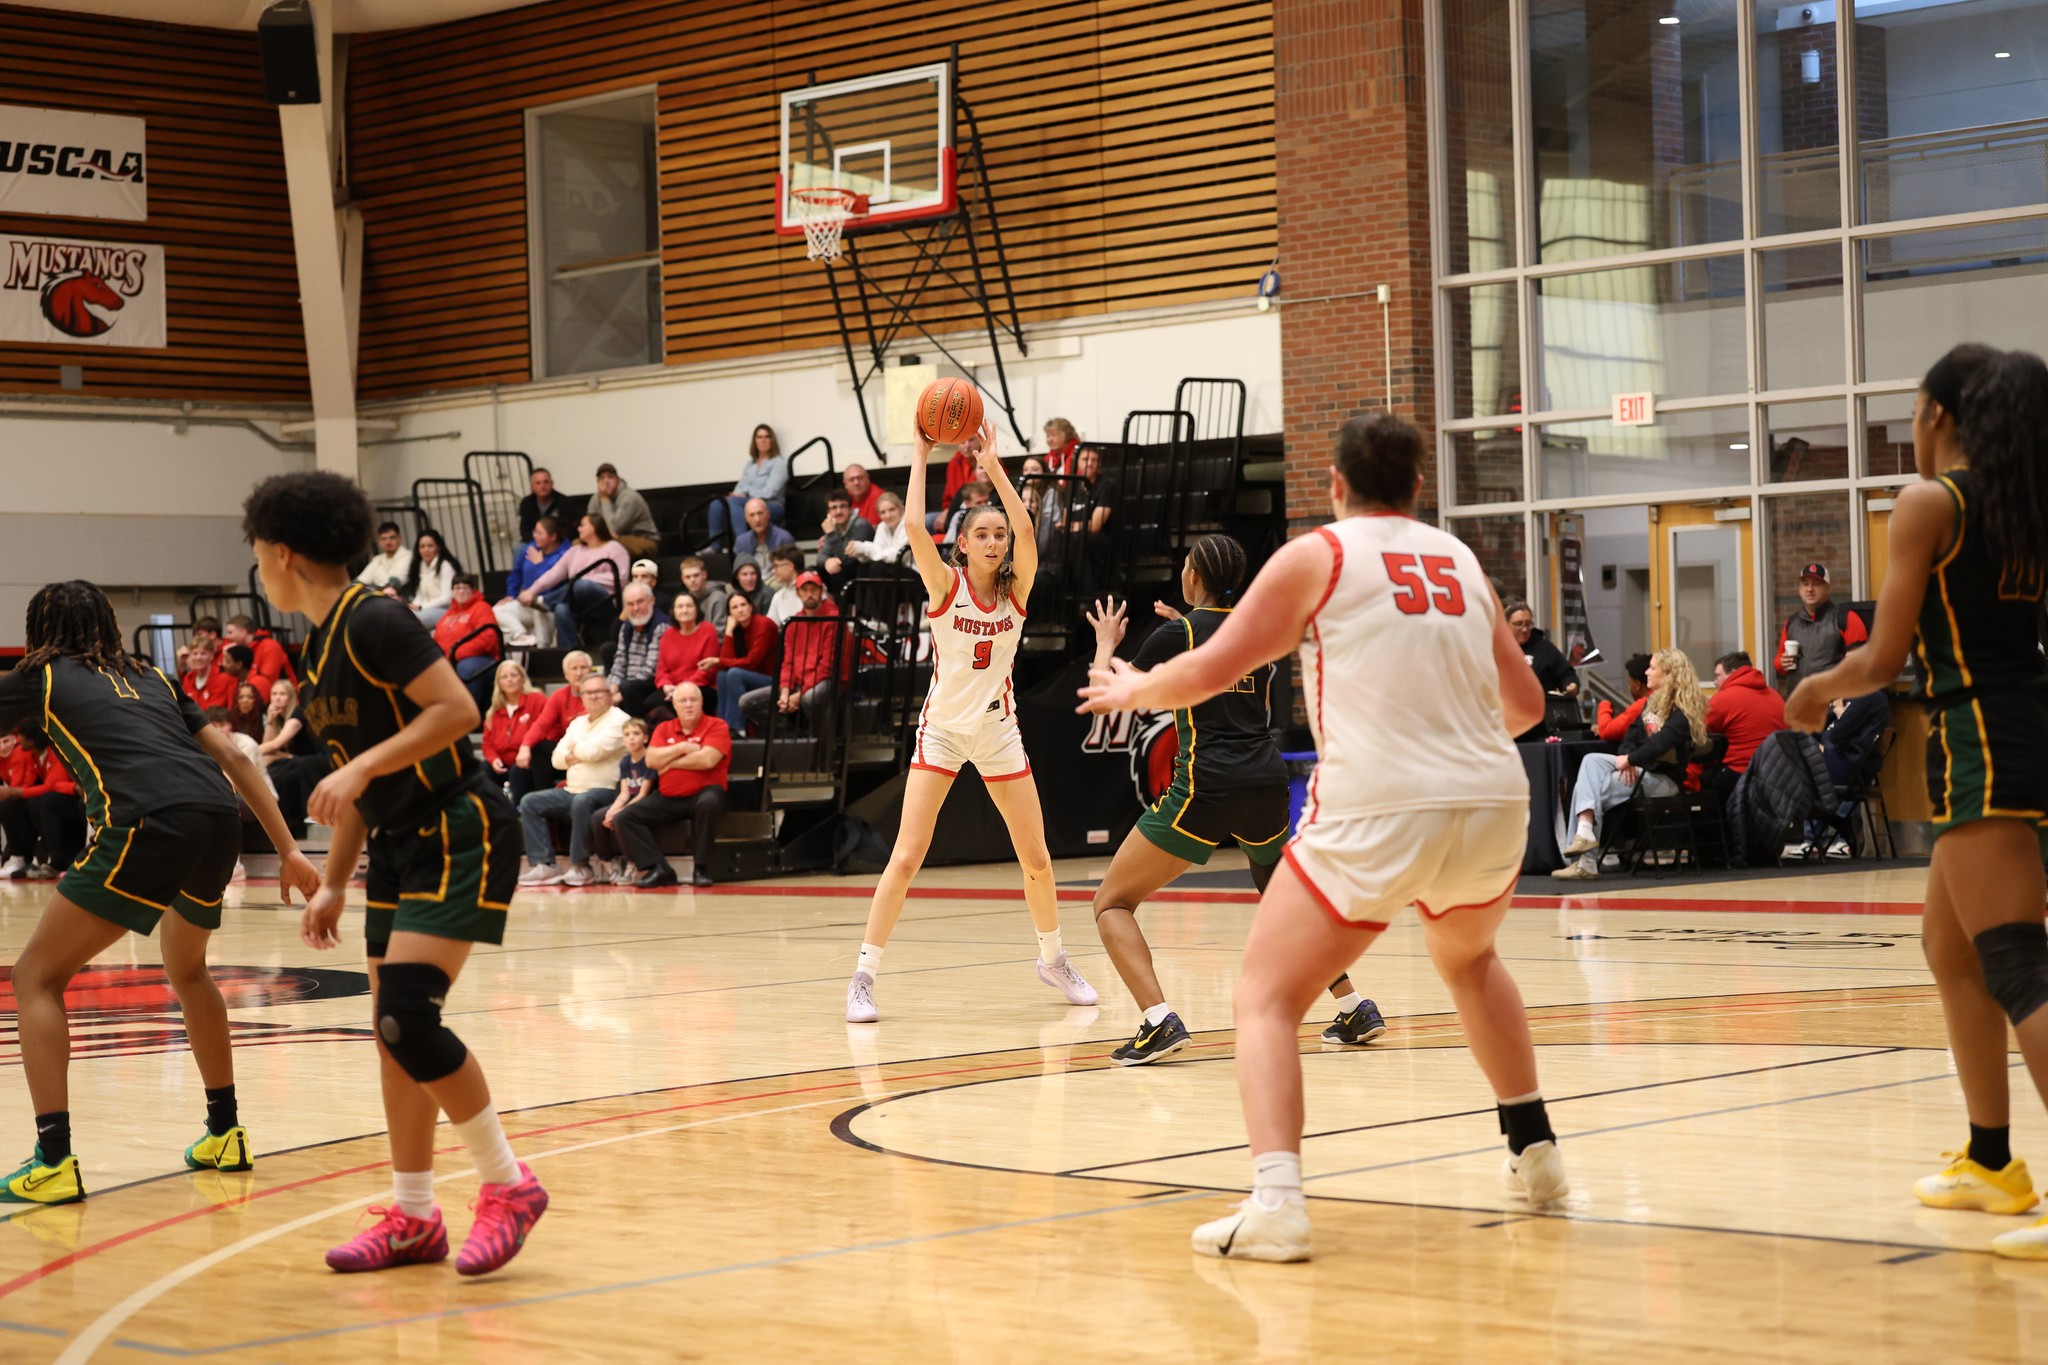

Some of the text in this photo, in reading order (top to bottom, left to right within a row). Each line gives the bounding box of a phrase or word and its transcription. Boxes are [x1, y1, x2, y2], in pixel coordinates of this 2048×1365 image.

[0, 141, 144, 183] USCAA
[4, 241, 146, 297] MUSTANGS
[946, 391, 961, 431] LEGACY
[1620, 396, 1645, 421] EXIT
[1381, 552, 1466, 616] 55
[953, 615, 1013, 636] MUSTANGS
[972, 640, 993, 669] 9
[98, 666, 139, 699] 1
